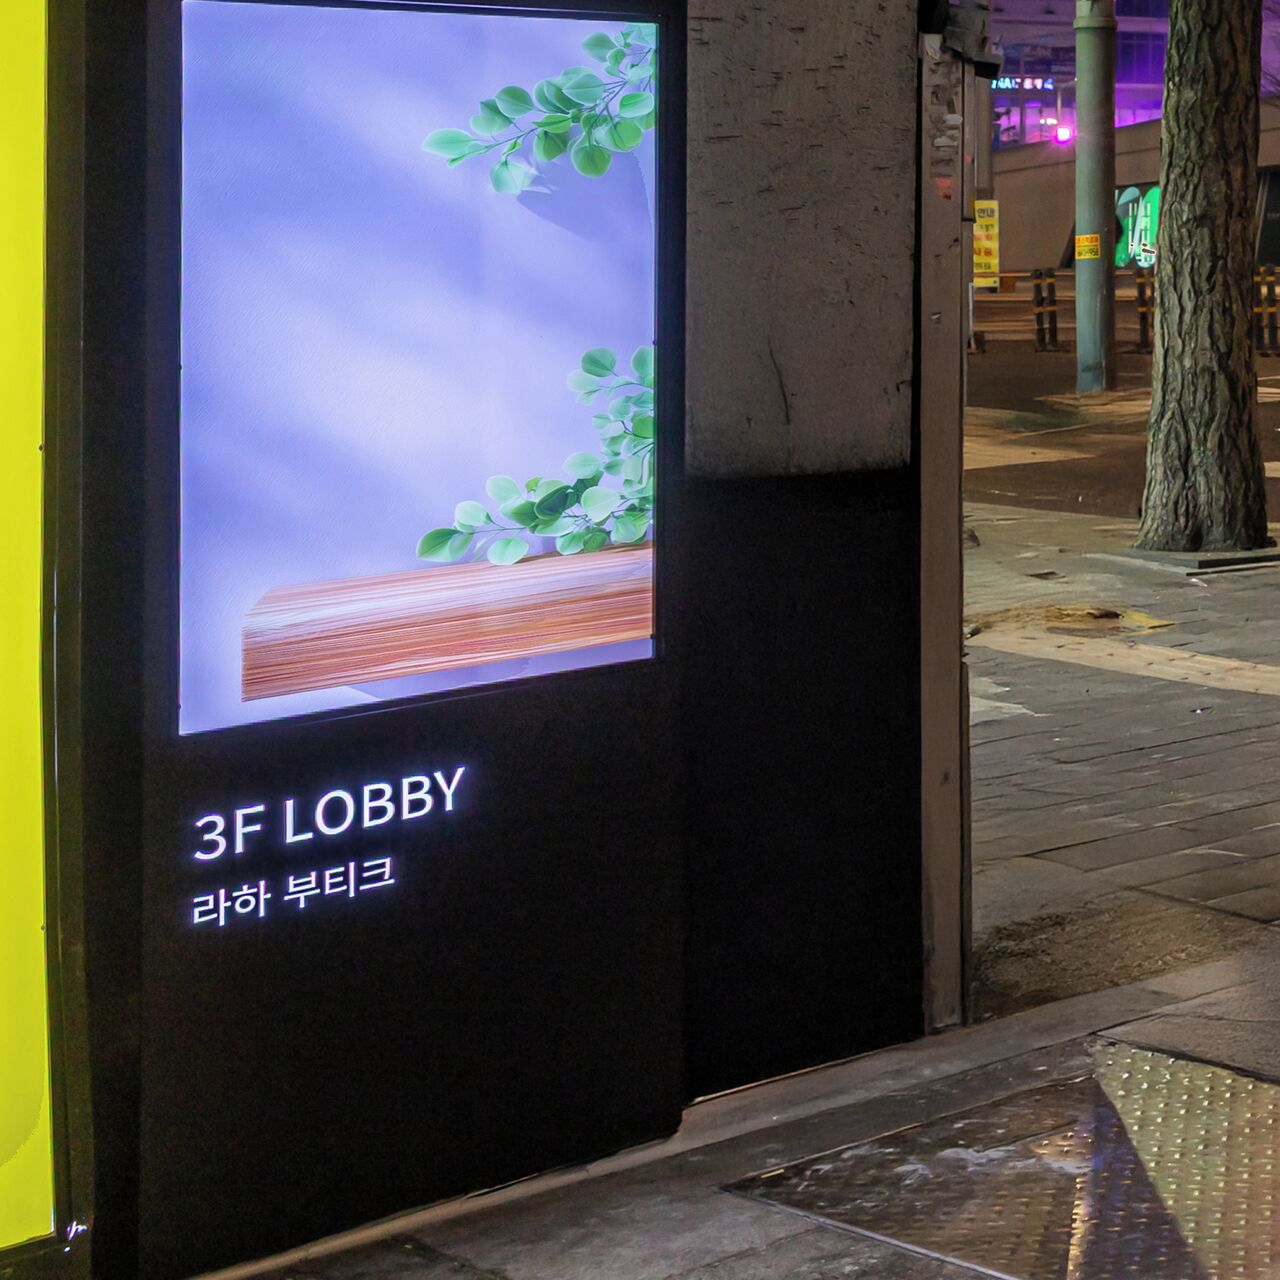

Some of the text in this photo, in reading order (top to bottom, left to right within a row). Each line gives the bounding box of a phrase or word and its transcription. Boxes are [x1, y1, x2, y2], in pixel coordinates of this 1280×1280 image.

[191, 763, 467, 863] 3F LOBBY
[190, 855, 396, 927] 라하 부티크
